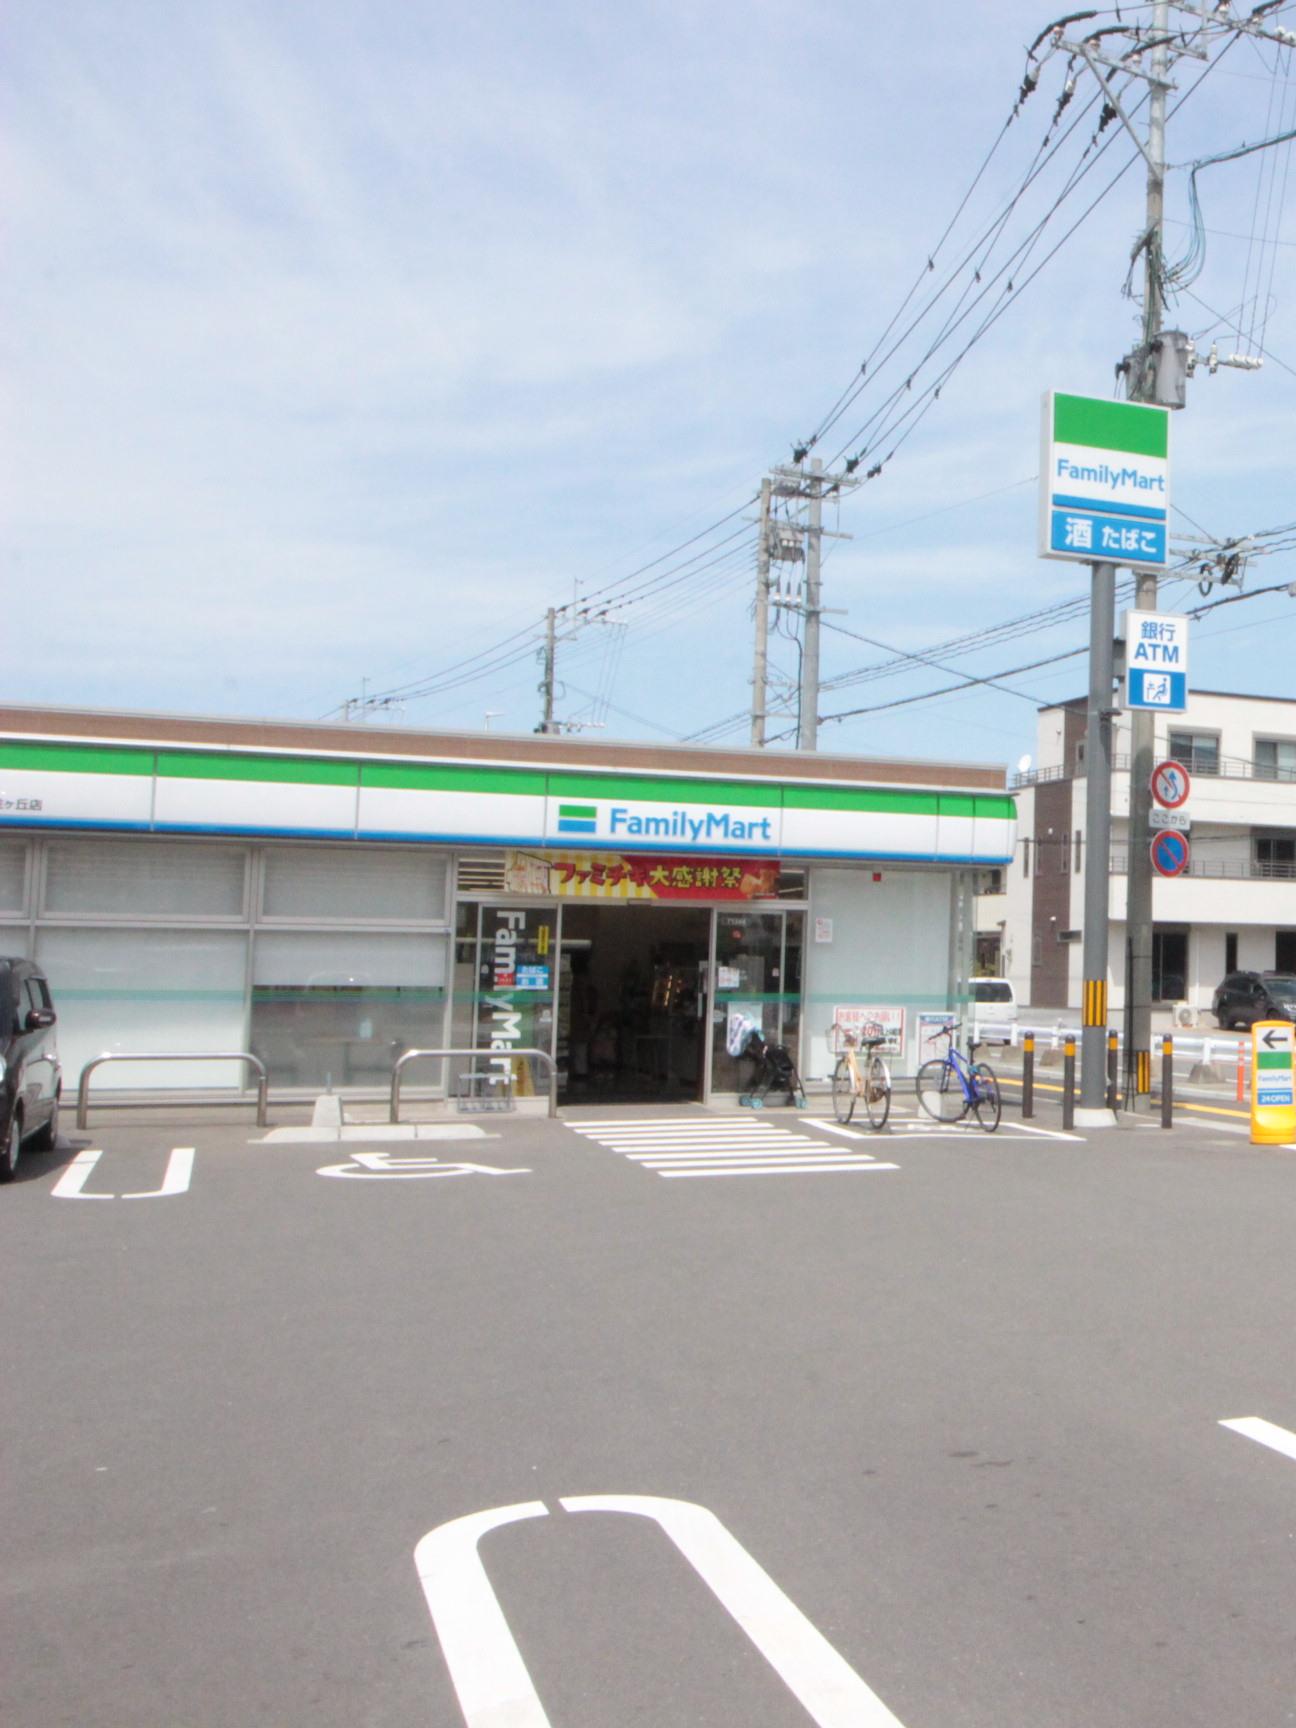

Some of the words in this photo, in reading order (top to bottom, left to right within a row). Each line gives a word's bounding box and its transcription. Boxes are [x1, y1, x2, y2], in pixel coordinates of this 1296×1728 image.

[1057, 459, 1164, 492] FamilyMart
[1065, 517, 1093, 549] 酒
[1101, 525, 1157, 553] たばこ
[1141, 621, 1176, 641] 銀行
[1134, 642, 1179, 663] ATM
[610, 808, 771, 840] FamilyMart
[1152, 812, 1186, 825] ここから
